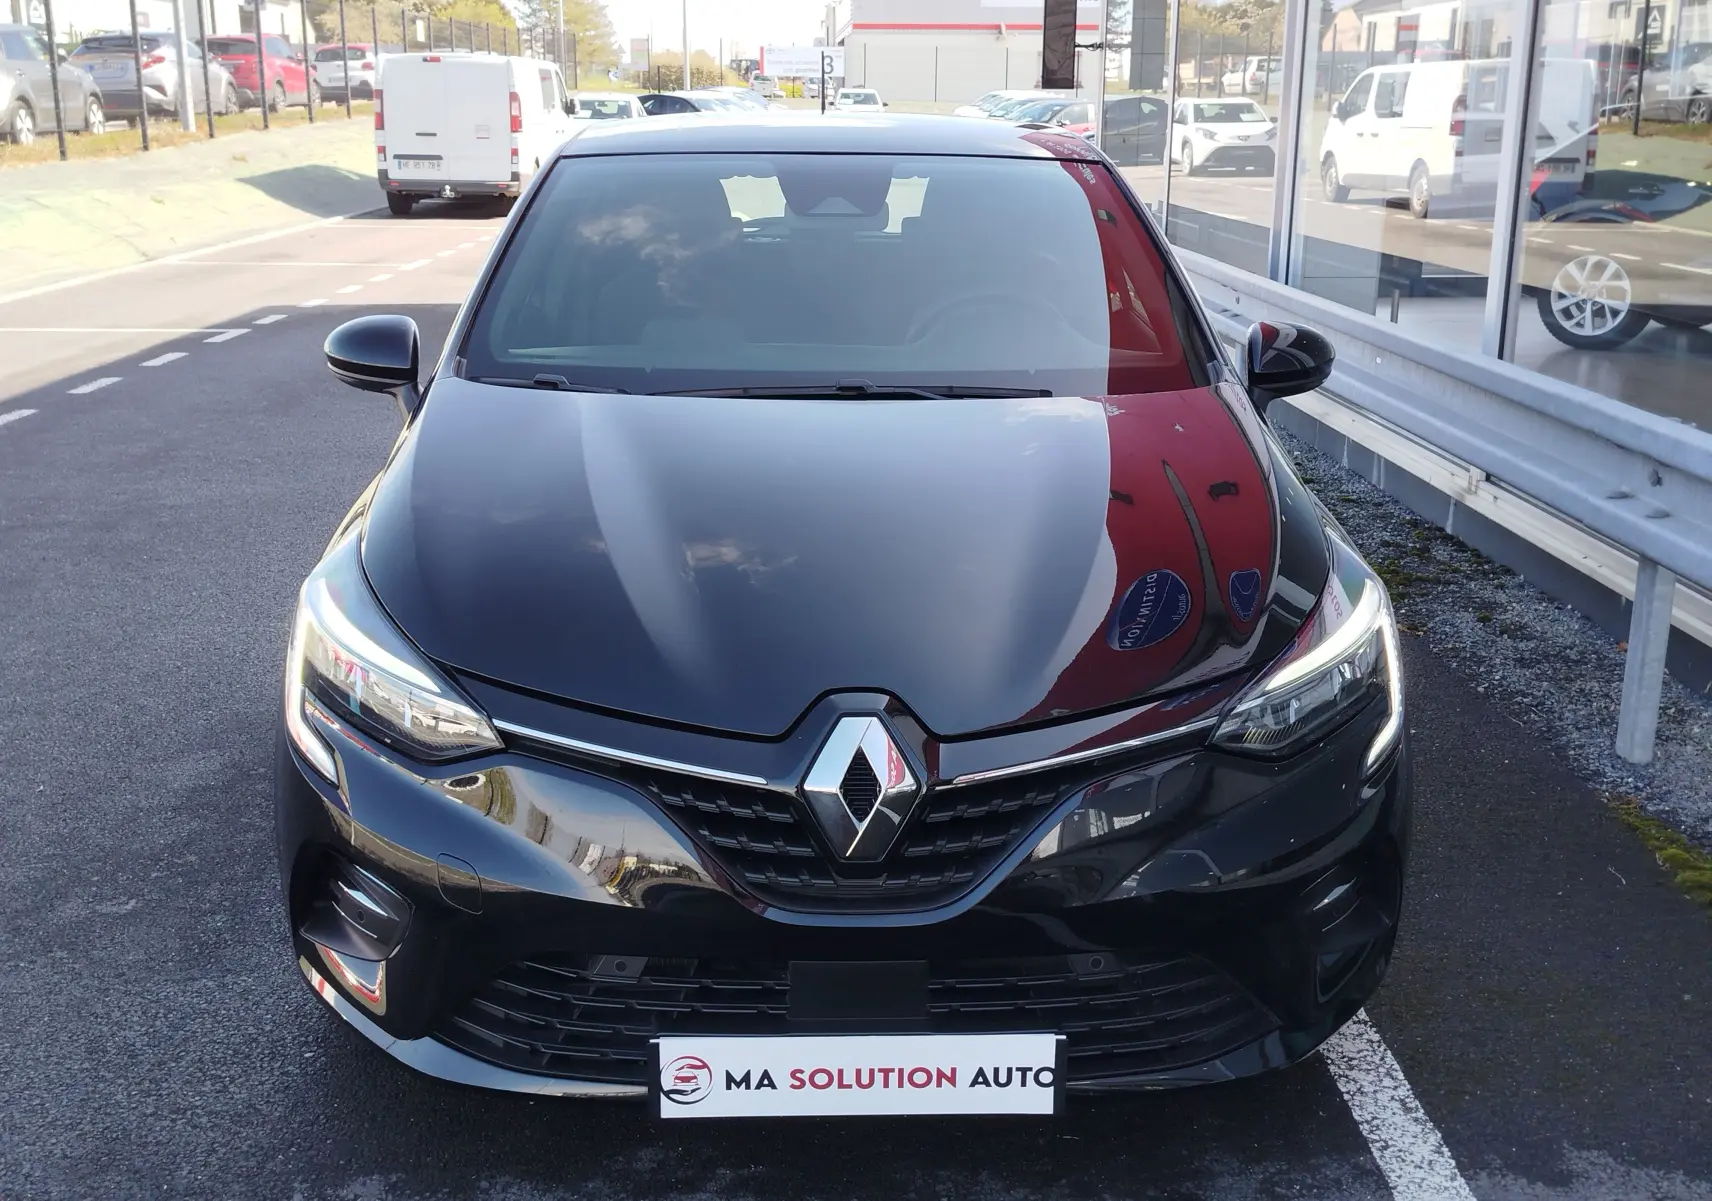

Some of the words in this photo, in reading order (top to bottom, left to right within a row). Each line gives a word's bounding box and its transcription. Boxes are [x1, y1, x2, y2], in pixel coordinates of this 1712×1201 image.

[725, 1068, 778, 1091] MA
[789, 1066, 957, 1090] SOLUTION
[968, 1066, 1056, 1089] AUTO
